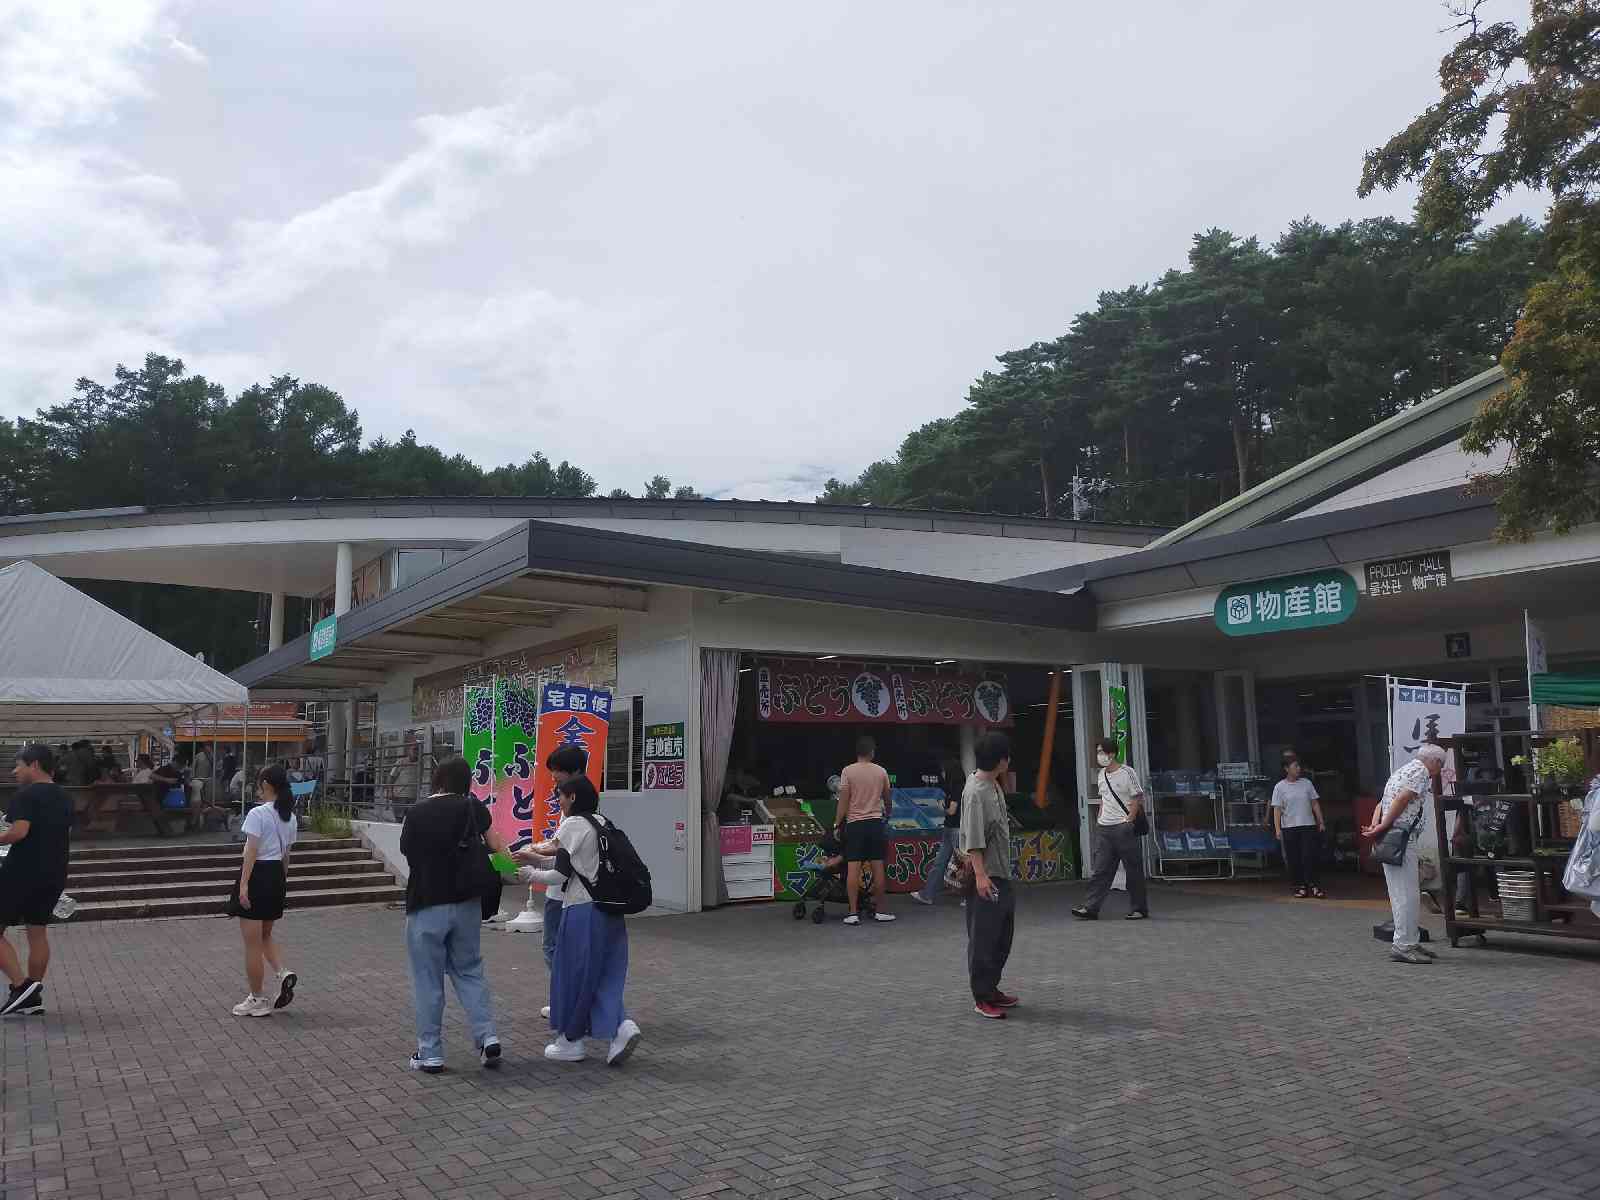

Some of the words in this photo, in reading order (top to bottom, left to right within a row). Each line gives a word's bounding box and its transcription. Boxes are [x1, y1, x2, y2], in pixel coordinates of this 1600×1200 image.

[1419, 555, 1445, 573] HALL
[1256, 580, 1342, 622] 物産館
[547, 688, 608, 715] 宅配便
[773, 673, 850, 717] ぶどう
[910, 679, 976, 719] ぶどう
